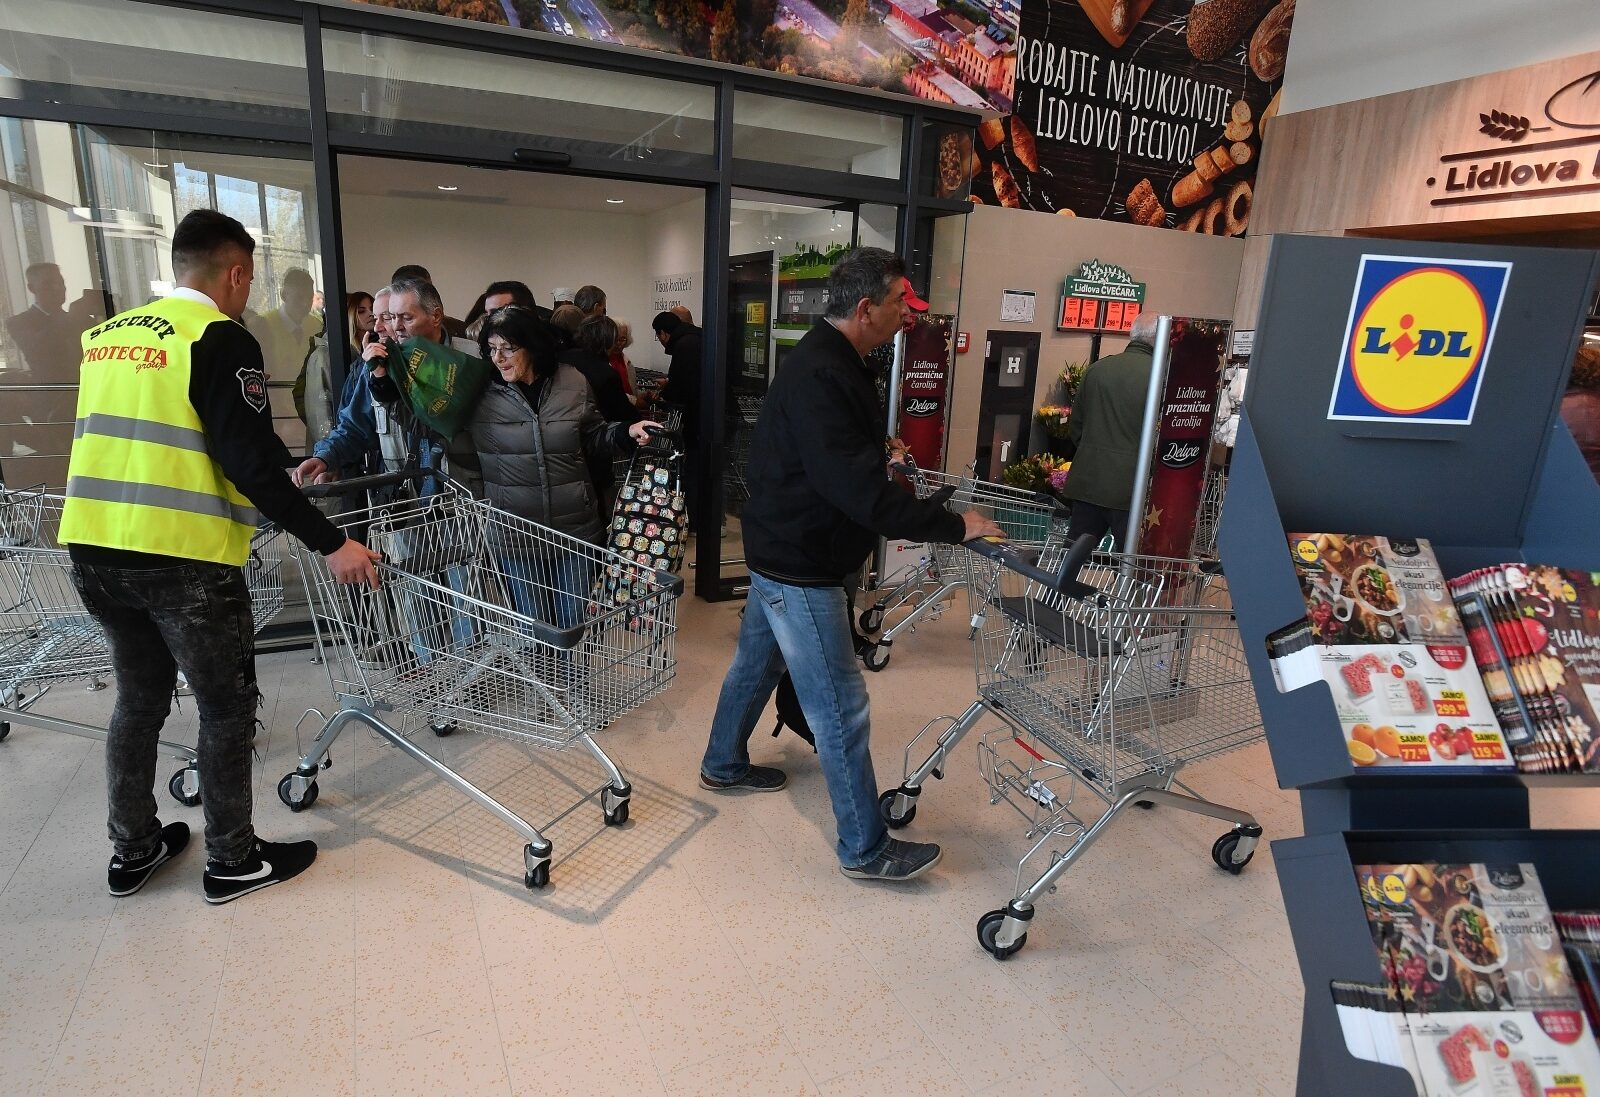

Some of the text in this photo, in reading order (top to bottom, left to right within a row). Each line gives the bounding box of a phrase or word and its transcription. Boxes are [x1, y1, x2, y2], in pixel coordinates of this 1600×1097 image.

[1106, 59, 1233, 128] NAJUKUSNIJE
[1036, 88, 1199, 166] LIDLOVO PECIVO!
[1445, 159, 1580, 192] Lidlova
[1074, 282, 1136, 298] Lidlova CVEĆARA
[89, 315, 176, 341] SECURITY
[81, 345, 168, 366] PROTECTA
[135, 361, 168, 375] group
[912, 360, 939, 369] Lidlova
[905, 370, 944, 381] praznična
[910, 380, 938, 391] čarolija
[1175, 386, 1207, 399] Lidlova
[906, 398, 938, 413] Deluxe
[1165, 400, 1211, 416] praznična
[1171, 415, 1203, 429] čarolija
[1162, 442, 1200, 462] Deluxe
[1395, 580, 1445, 592] elegancije!
[1494, 922, 1554, 937] elegancije!
